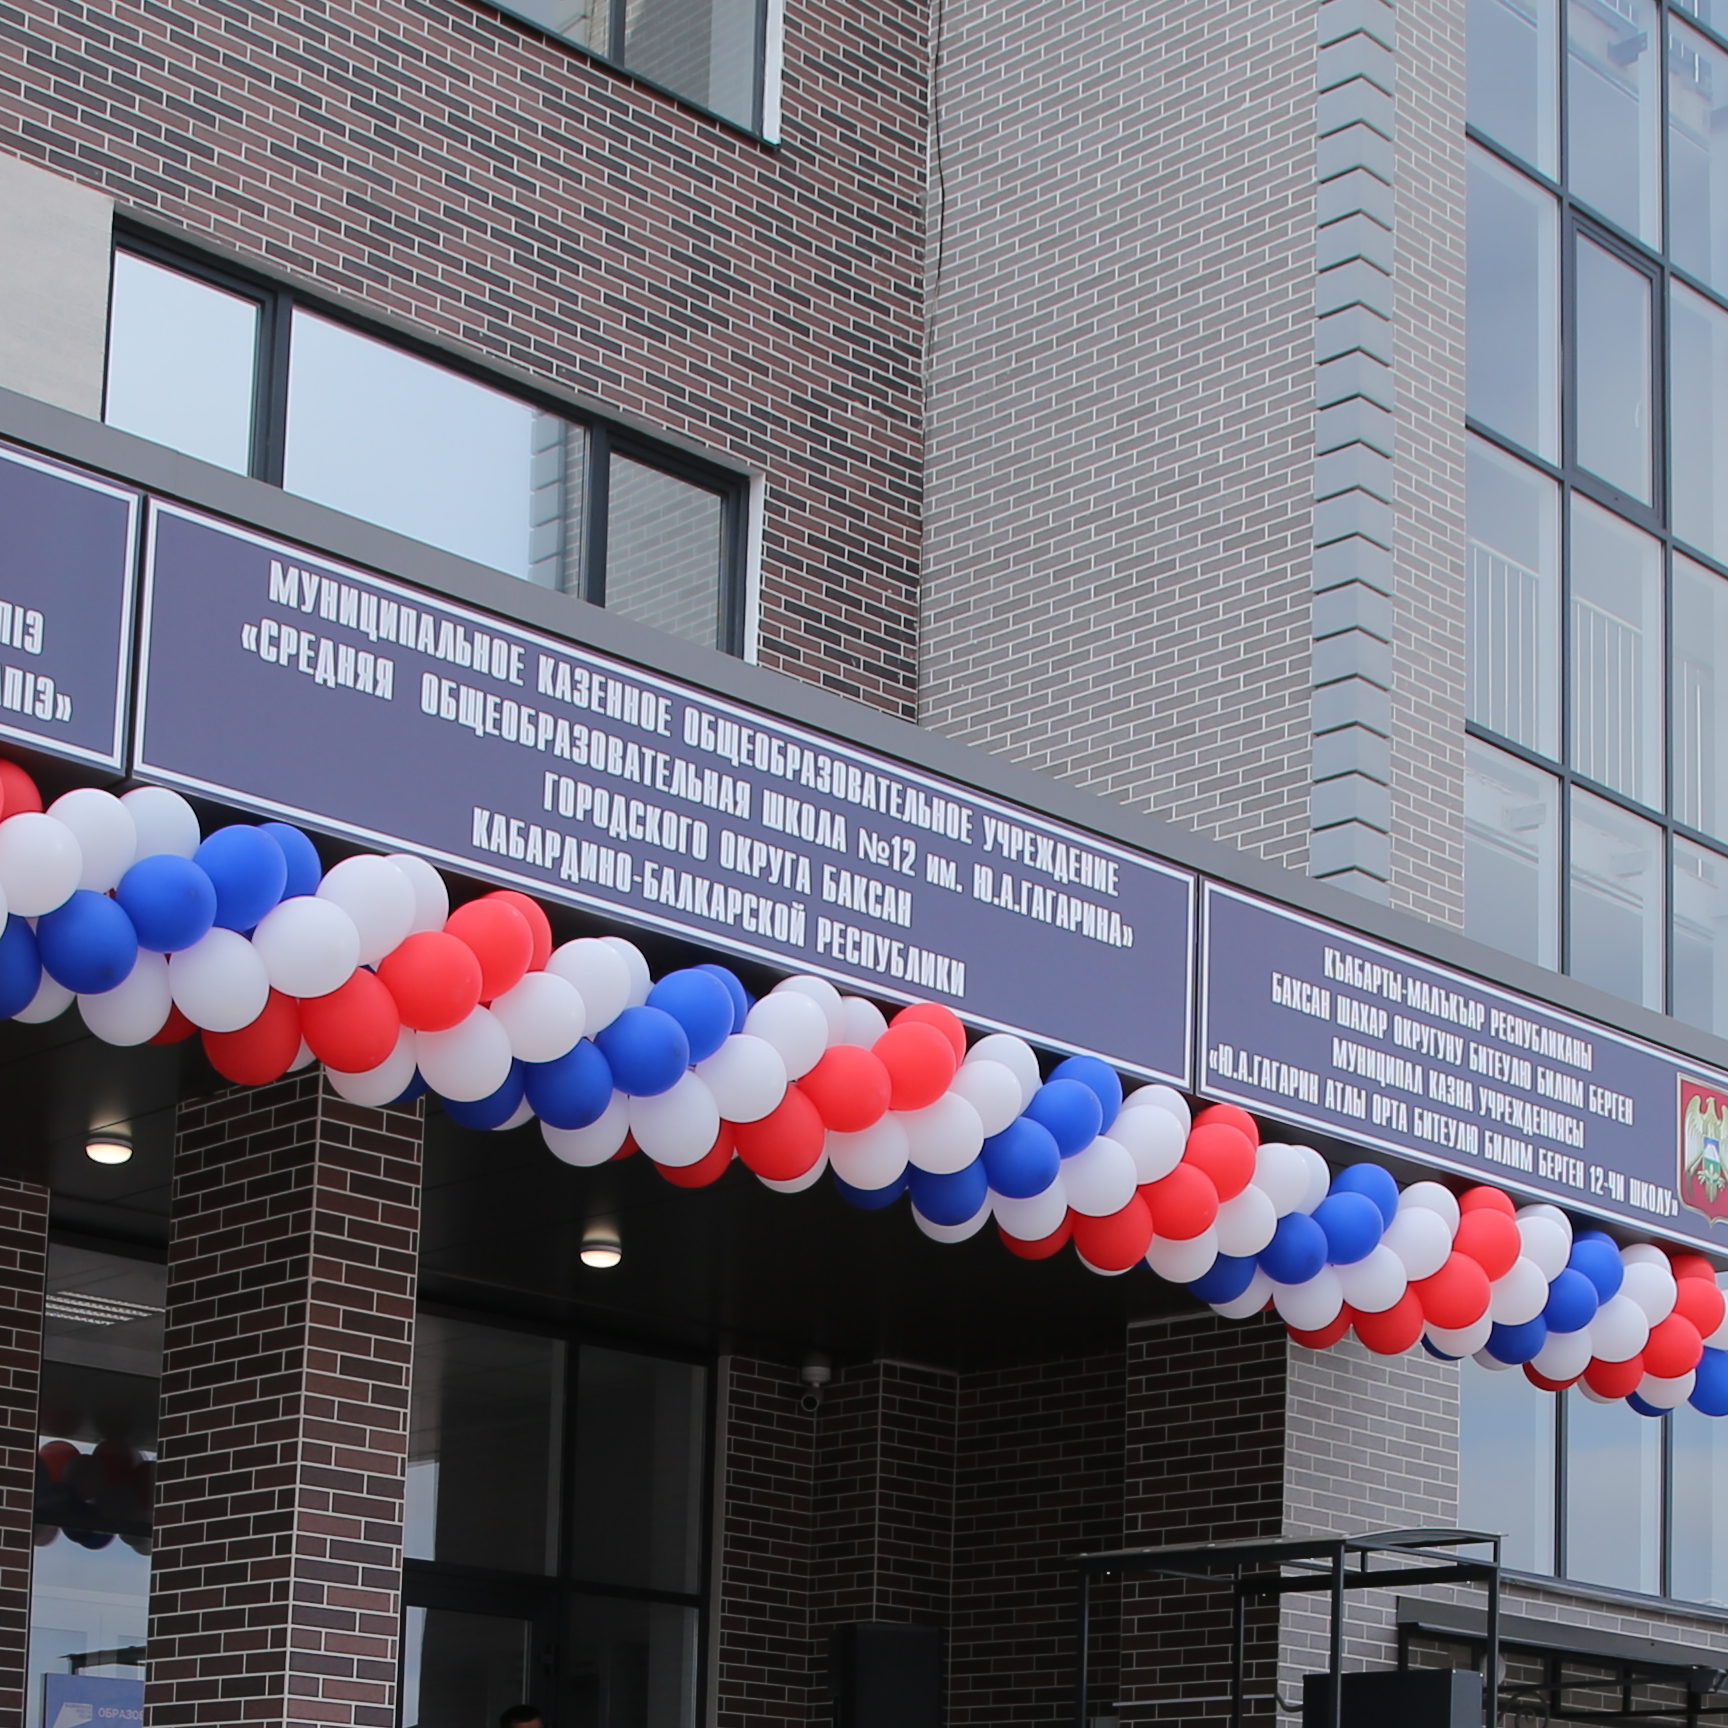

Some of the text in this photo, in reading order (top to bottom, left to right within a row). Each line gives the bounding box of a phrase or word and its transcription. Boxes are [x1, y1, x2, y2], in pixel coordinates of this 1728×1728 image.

[242, 619, 1133, 947] «СРЕДНЯЯ ОБЩЕОБРАЗОВАТЕЛЬНАЯ ШКОЛА №12 ИМ. Ю.А.ГАГАРИНА»
[270, 560, 1118, 896] МУНИЦИПАЛЬНОЕ КАЗЕННОЕ ОБЩЕОБРАЗОВАТЕЛЬНОЕ УЧРЕЖДЕНИЕ
[473, 807, 964, 997] КАБАРДИНО-БАЛКАРСКОЙ РЕСПУБЛИКИ
[544, 772, 911, 927] ГОРОДСКОГО ОКРУГА БАКСАН
[1273, 972, 1632, 1125] БАХСАН ШАХАР ОКРУГУНУ БИТЕУЛЮ БИЛИМ БЕРГЕН
[1325, 947, 1591, 1071] КЪАБАРТЫ-МАЛЪКЪАР РЕСПУБЛИКАНЫ
[1209, 1044, 1678, 1216] «Ю.А.ГАГАРИН АТЛЫ ОРТА БИТЕУЛЮ БИЛИМ БЕРГЕН 12-ЧИ ШКОЛУ»
[1333, 1037, 1583, 1148] МУНИЦИПАЛ КАЗНА УЧРЕЖДЕНИЯСЫ
